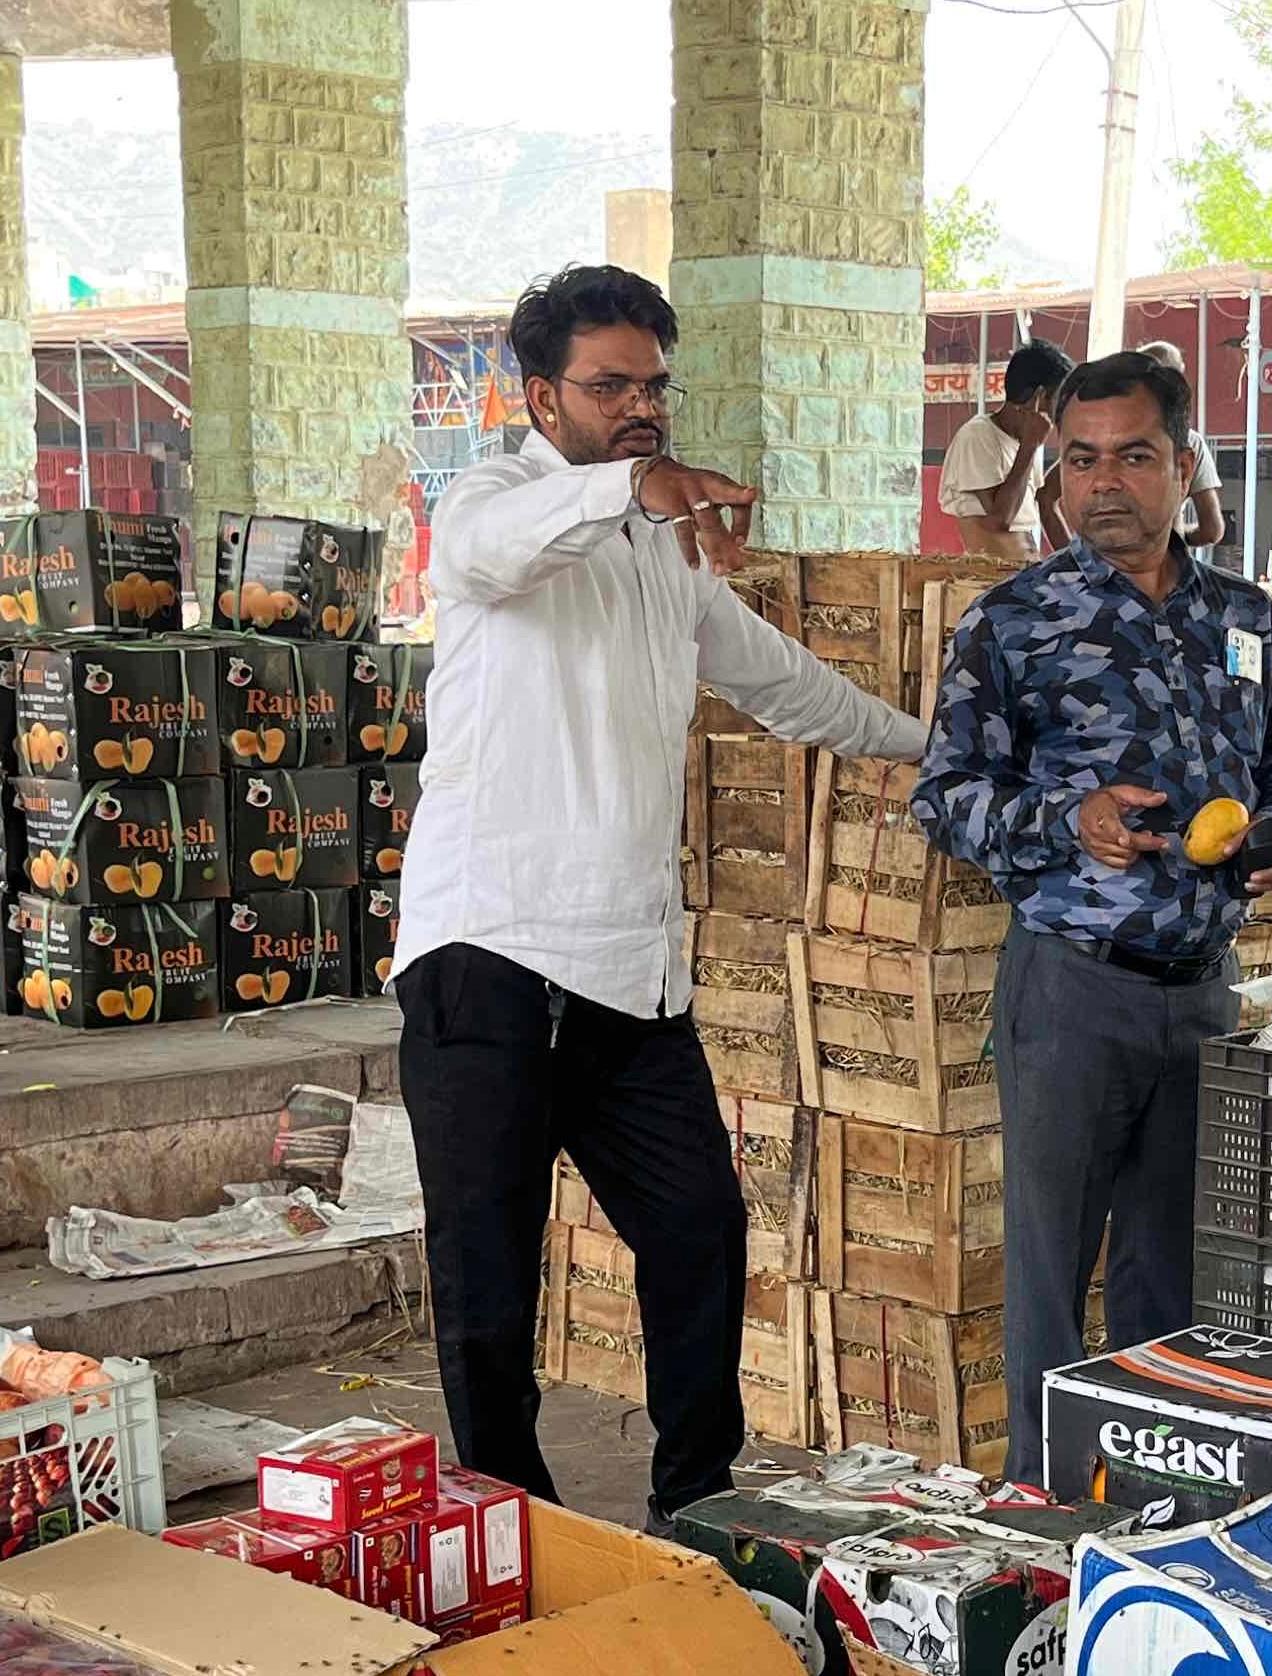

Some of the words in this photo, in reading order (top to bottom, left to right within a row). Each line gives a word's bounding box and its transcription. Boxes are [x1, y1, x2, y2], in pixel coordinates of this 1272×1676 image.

[2, 544, 76, 579] Raesh
[117, 816, 216, 853] Rajsh
[266, 806, 349, 838] Rajesh
[252, 929, 340, 963] Rajeh
[165, 973, 208, 985] OMPANY
[1098, 1419, 1246, 1486] egast
